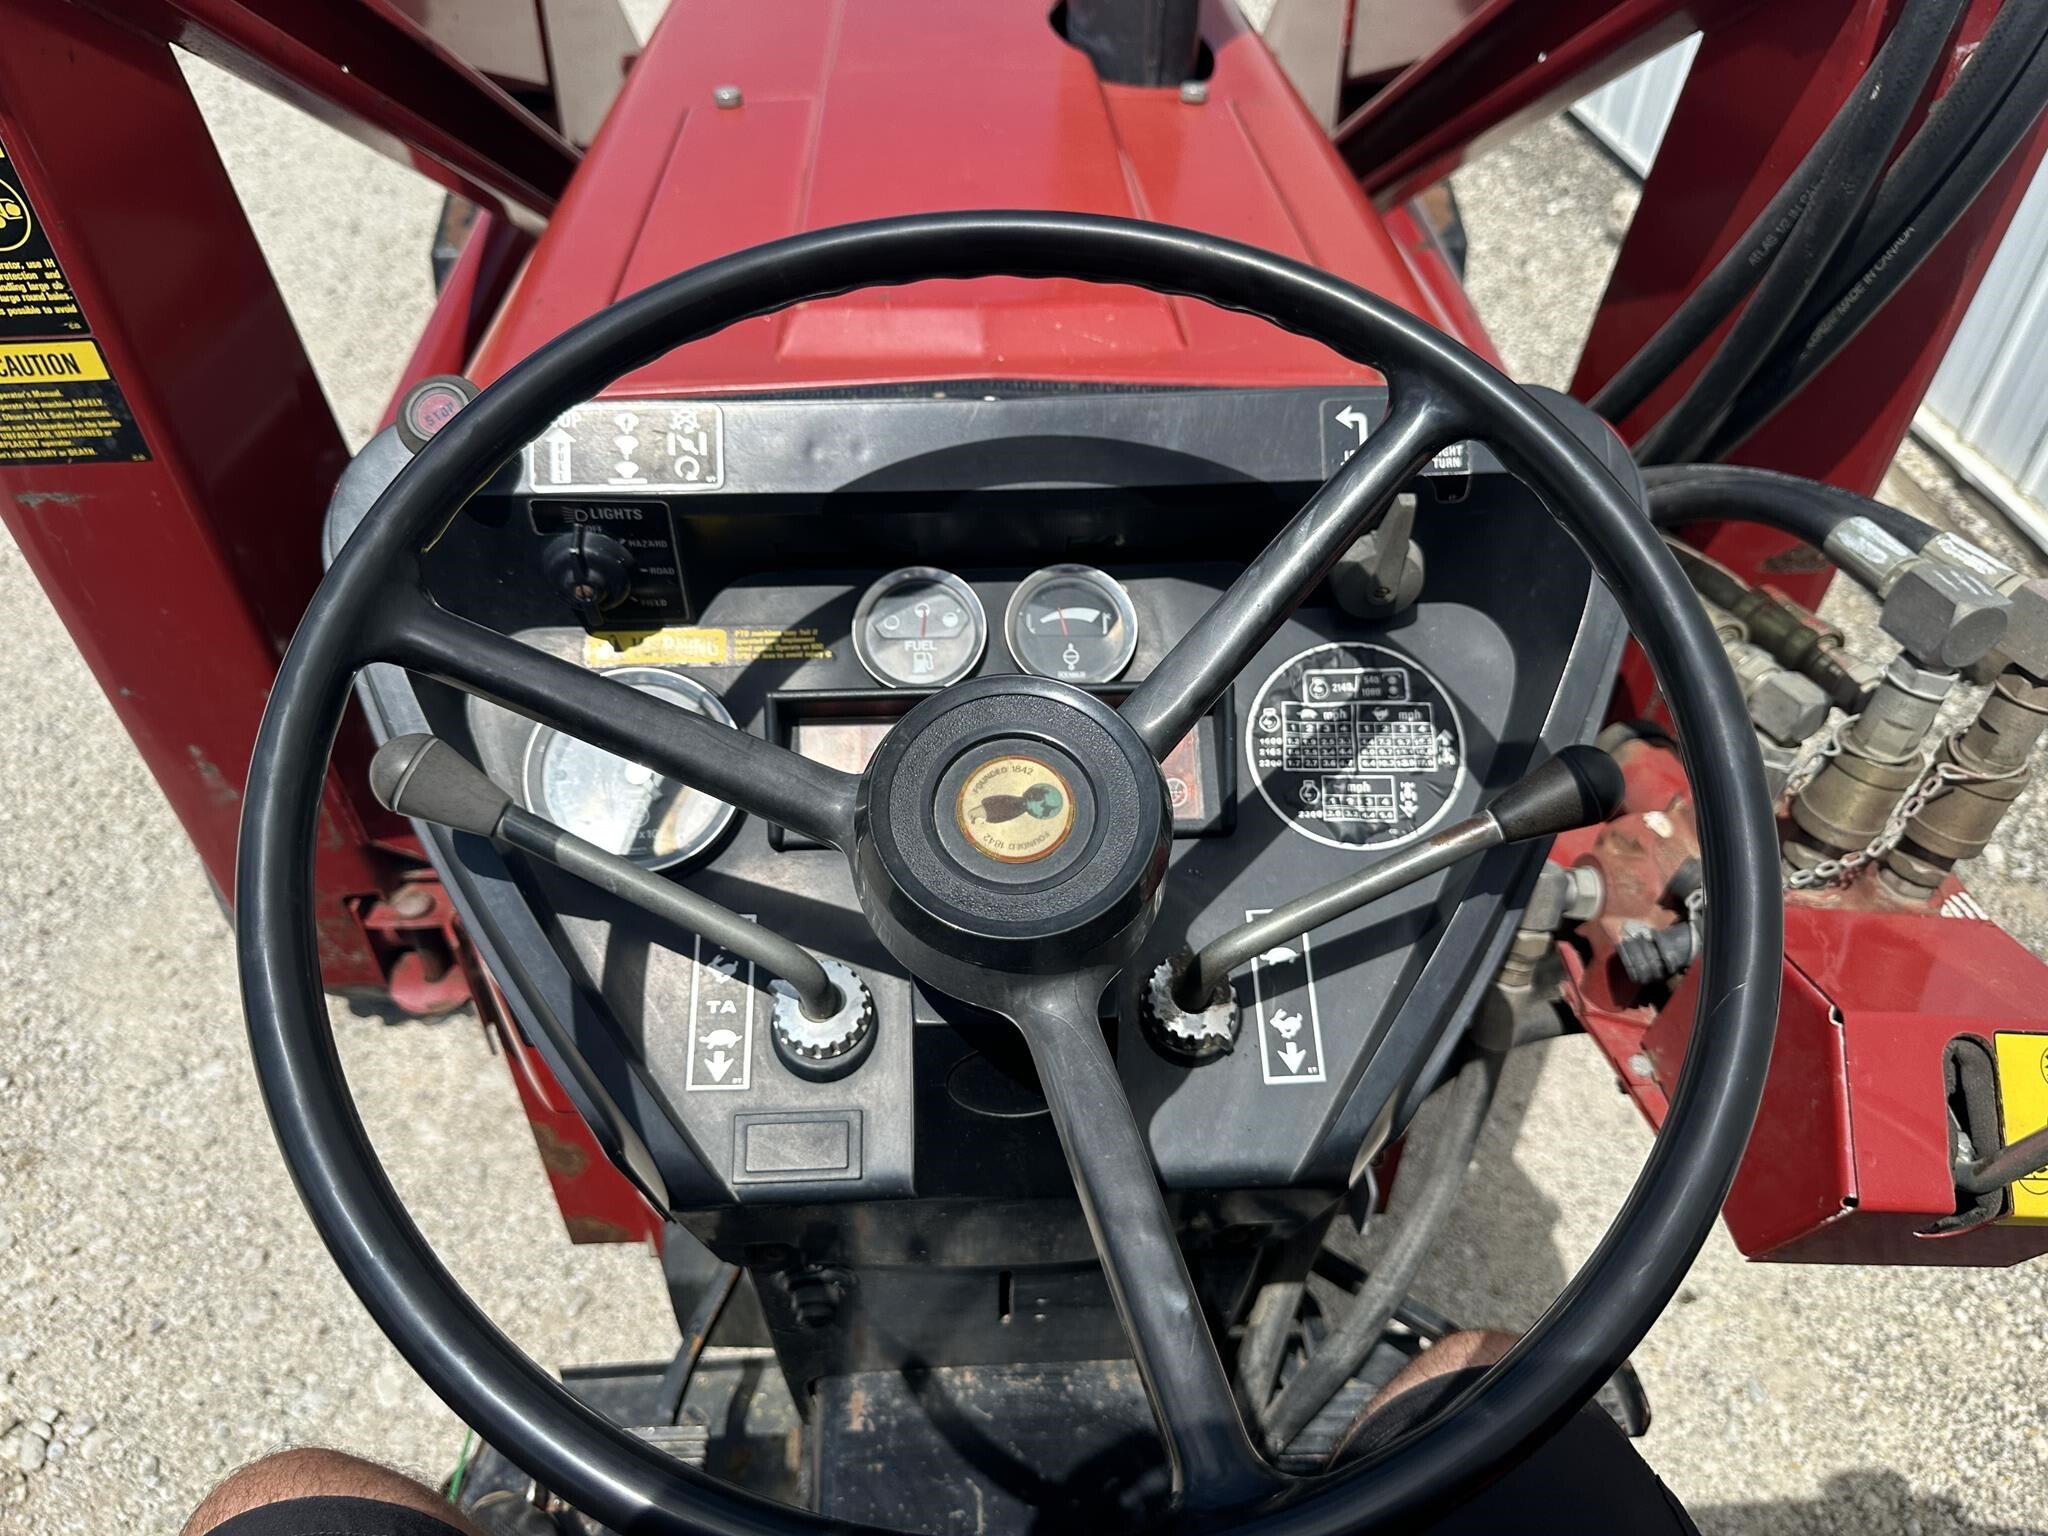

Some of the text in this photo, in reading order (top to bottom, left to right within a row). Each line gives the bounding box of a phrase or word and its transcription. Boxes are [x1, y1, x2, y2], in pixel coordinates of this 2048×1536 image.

[0, 261, 25, 270] rator,
[0, 271, 39, 280] rotection
[0, 282, 27, 293] ndling
[0, 391, 32, 400] perator's
[0, 403, 24, 411] perate
[424, 402, 455, 428] STOP
[0, 440, 40, 448] PLACENT
[1437, 444, 1463, 457] IGHT
[1431, 457, 1462, 469] TURN
[591, 508, 643, 521] LIGHTS
[629, 540, 668, 548] HAZARD
[651, 567, 675, 576] ROAD
[641, 599, 667, 607] FIELD
[904, 640, 937, 651] FUEL
[1323, 708, 1423, 722] mph mph
[1305, 723, 1314, 732] 2
[1323, 724, 1331, 732] 3
[1399, 724, 1408, 732] 3
[972, 765, 1034, 794] FOUNDED 1842
[1347, 781, 1372, 793] mph
[1365, 797, 1374, 806] 3
[1381, 798, 1391, 806] 4
[983, 832, 1050, 851] FOUNDED 1842
[706, 1000, 737, 1014] TA
